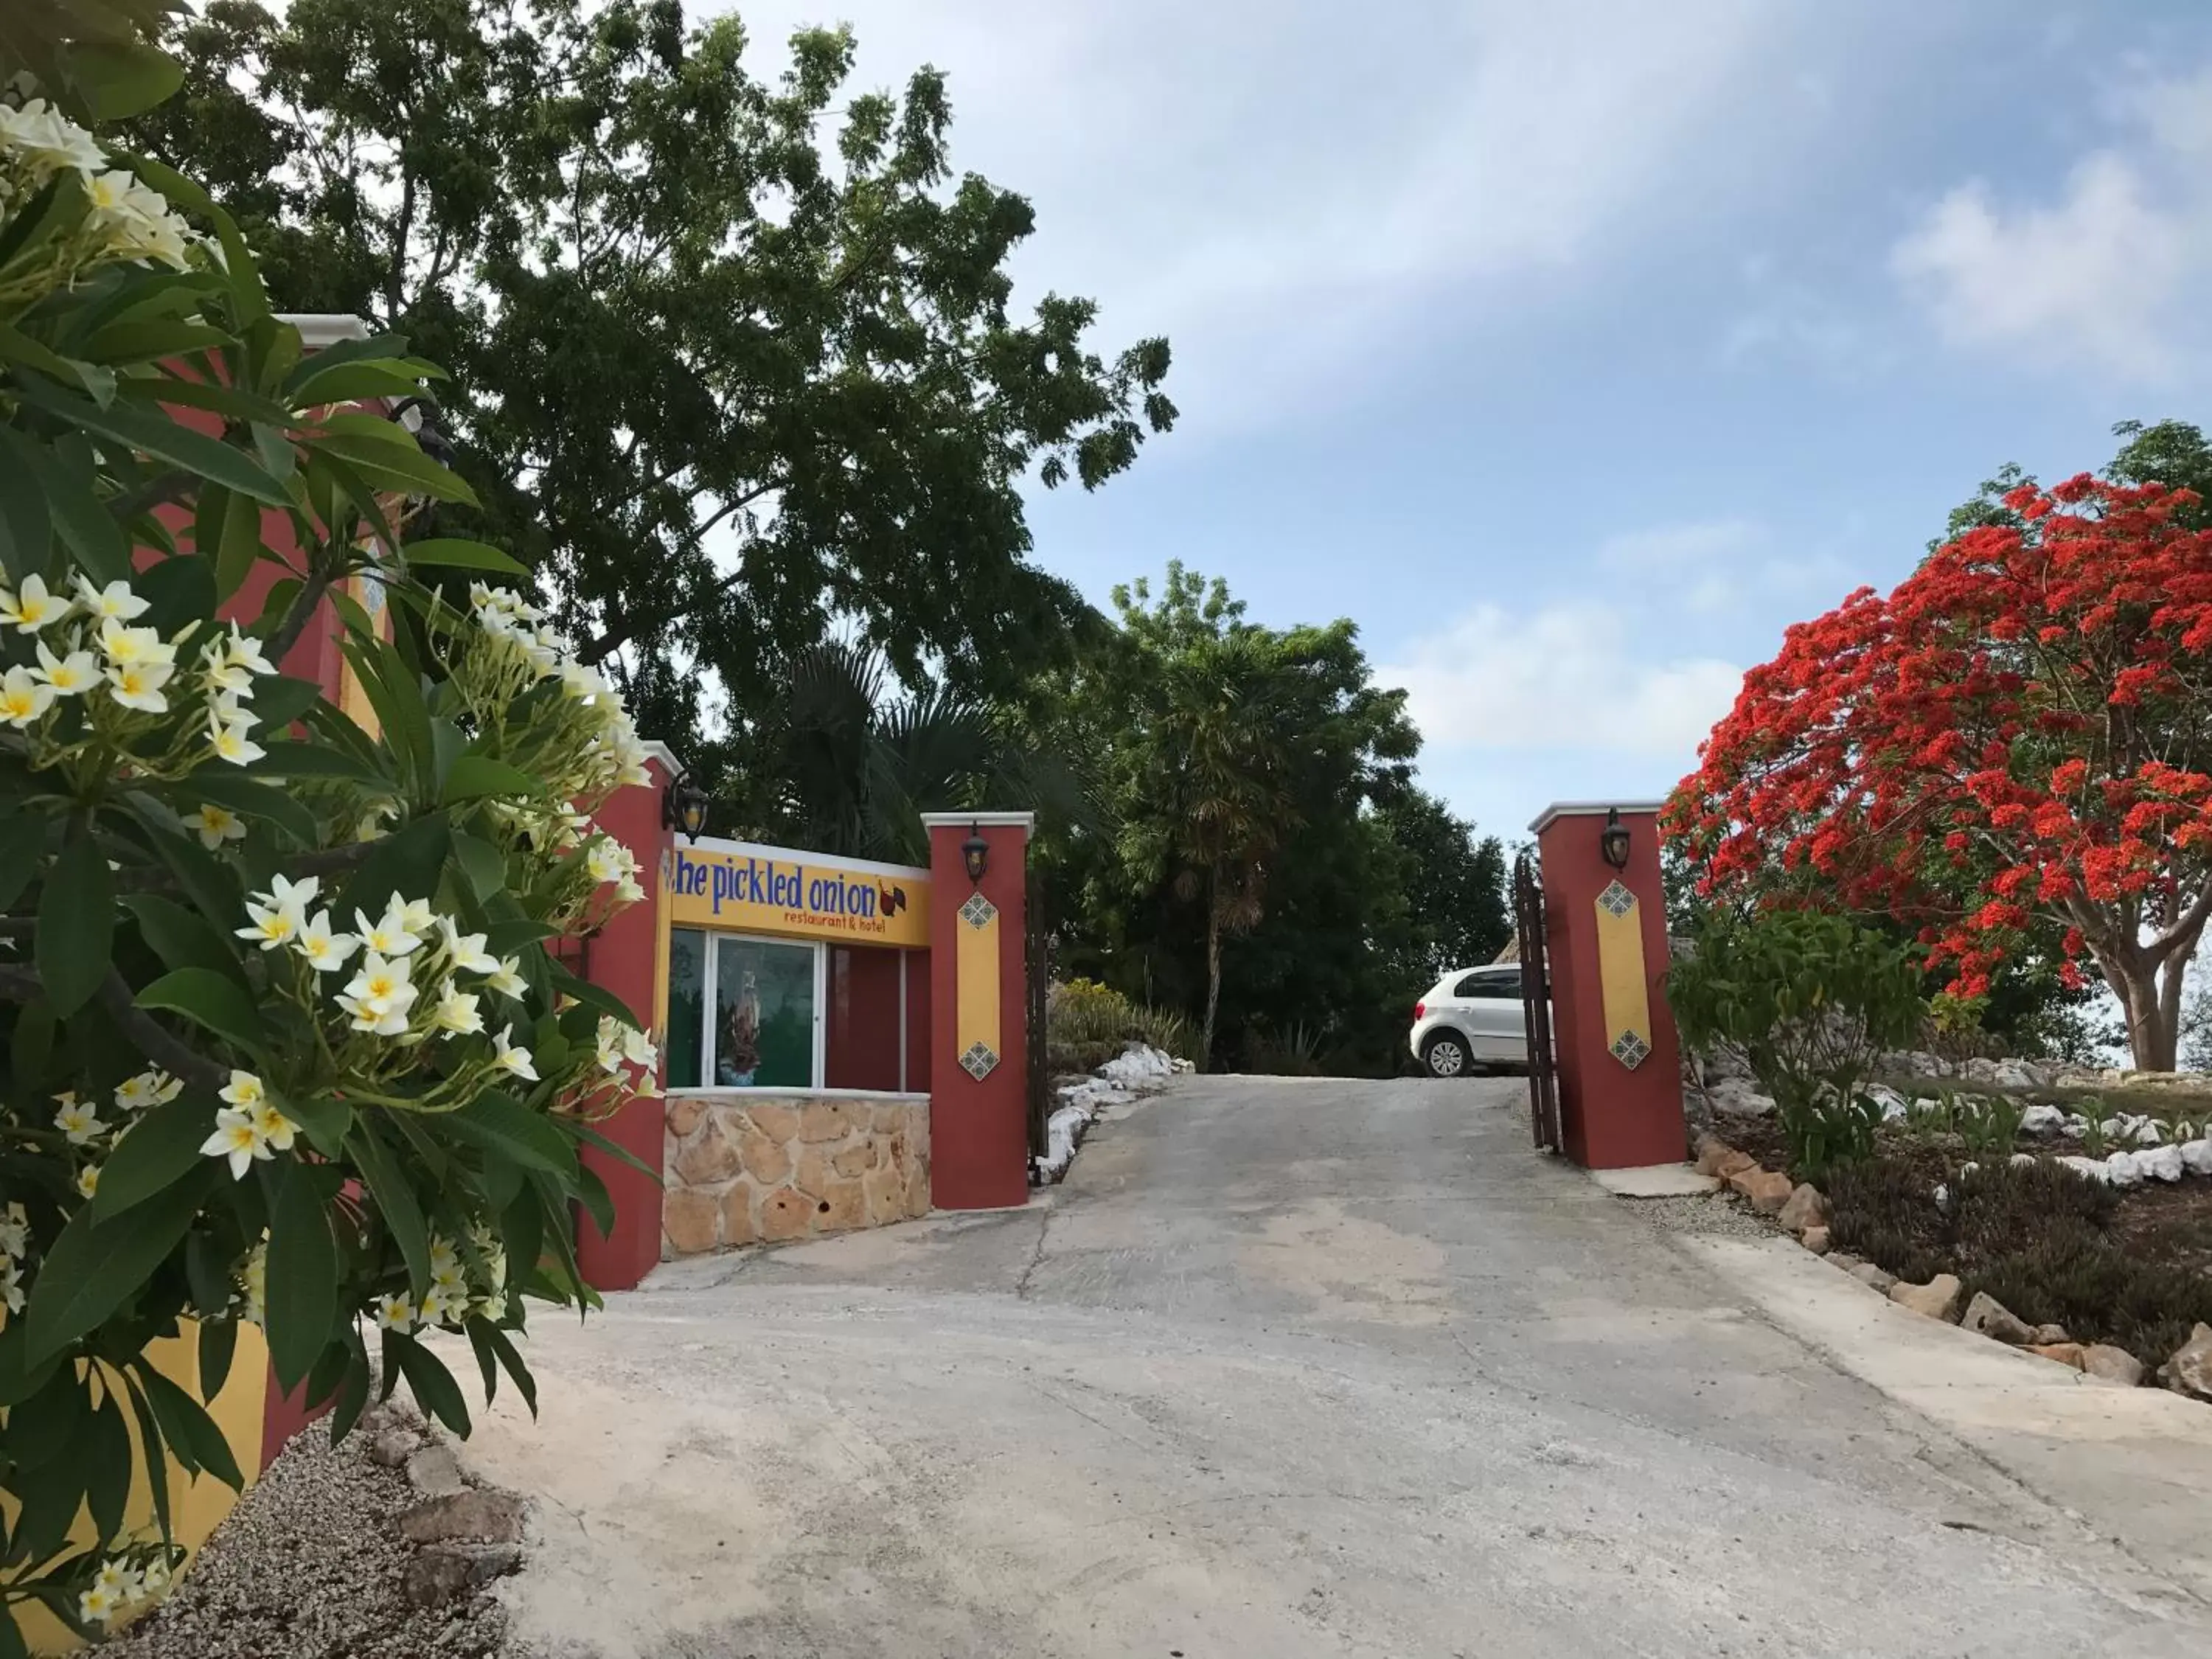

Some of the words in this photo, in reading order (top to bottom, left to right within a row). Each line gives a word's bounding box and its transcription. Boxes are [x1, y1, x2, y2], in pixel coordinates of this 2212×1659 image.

[672, 850, 707, 896] he
[712, 858, 803, 914] pickled
[808, 873, 877, 917] onion
[785, 911, 846, 929] restaurant
[849, 915, 856, 929] &
[860, 917, 886, 933] hotel
